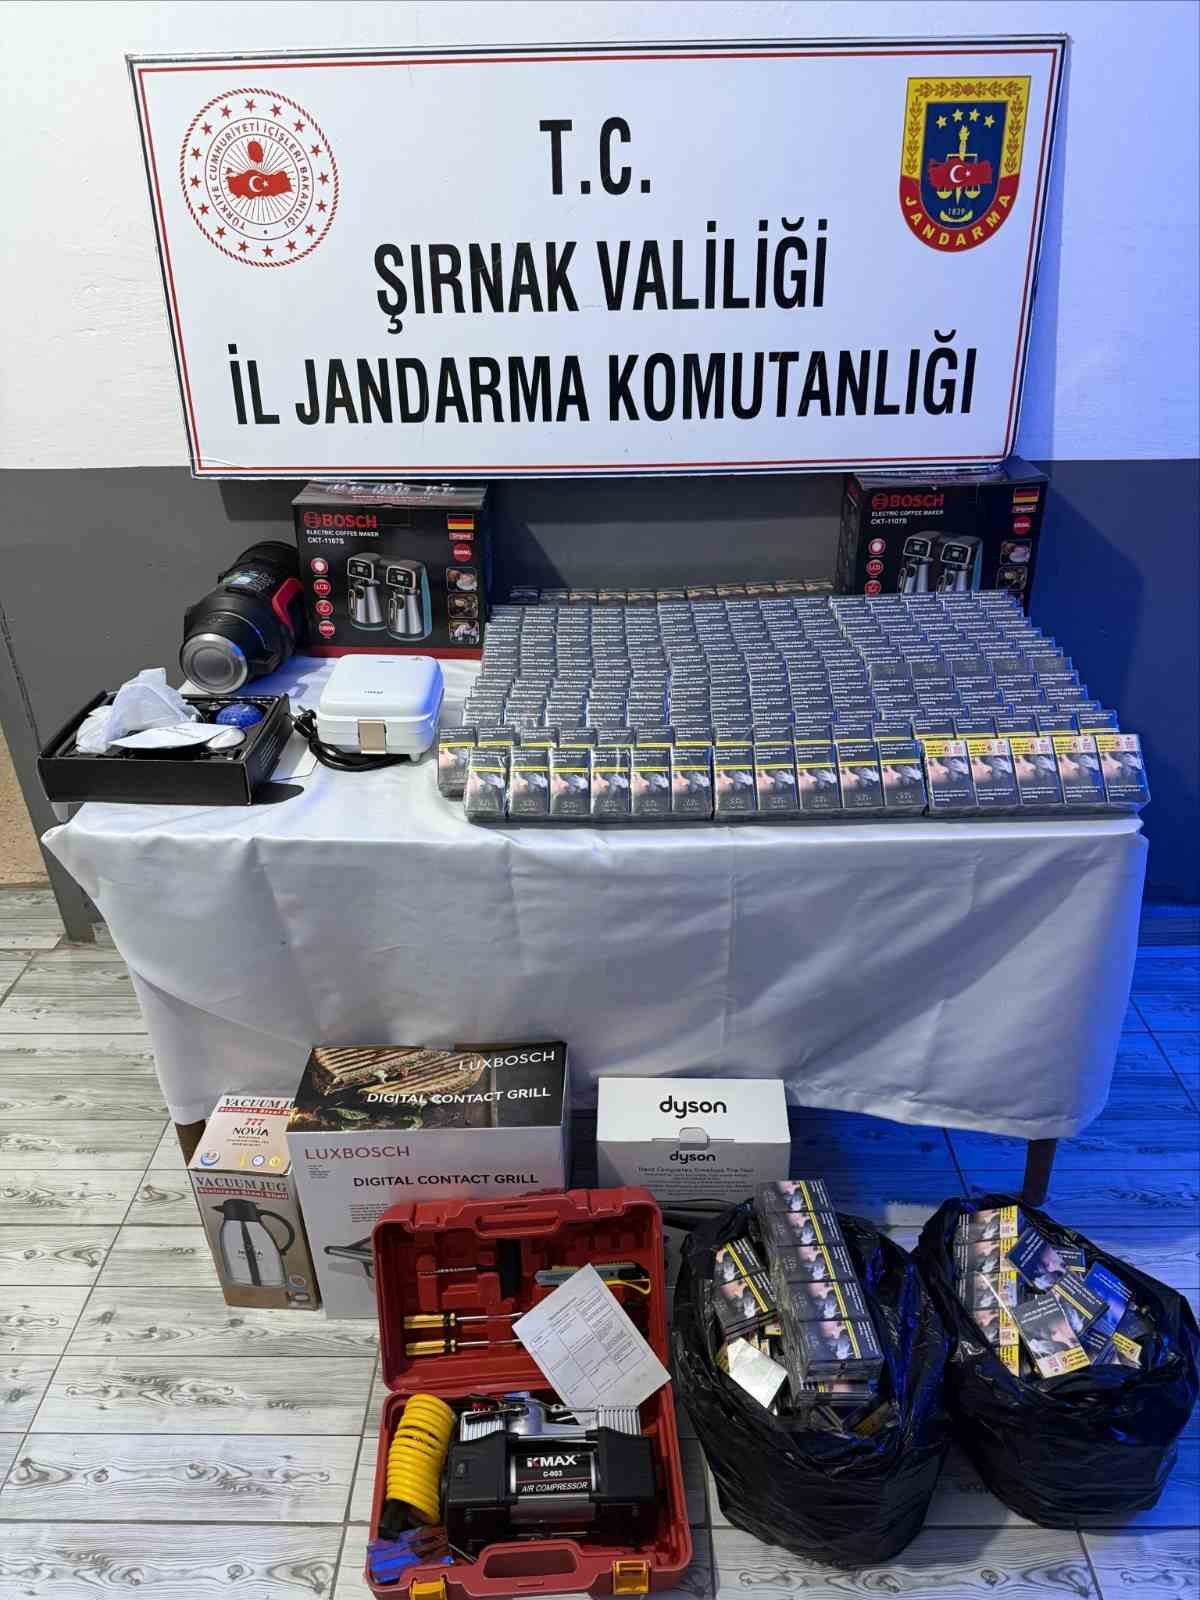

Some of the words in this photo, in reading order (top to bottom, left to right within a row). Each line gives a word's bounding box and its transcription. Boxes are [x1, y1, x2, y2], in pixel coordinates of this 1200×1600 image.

[209, 119, 260, 181] CUMHURİYETİ
[263, 121, 302, 163] İÇİŞLERİ
[539, 117, 651, 195] T.C.
[904, 194, 1011, 246] JANDARMA
[374, 241, 580, 335] ŞIRNAK
[597, 216, 829, 311] VALİLİĞİ
[227, 342, 281, 425] İL
[295, 354, 591, 425] JANDARMA
[608, 329, 978, 422] KOMUTANLIĞI
[890, 494, 945, 507] BOSCH
[322, 514, 377, 529] BOSCH
[459, 1050, 555, 1072] LUXBOSCH
[225, 1098, 280, 1108] VACUUM
[366, 1092, 428, 1105] DIGITAL
[431, 1091, 504, 1104] CONTACT
[507, 1087, 552, 1100] GRILL
[659, 1095, 728, 1119] dyson
[304, 1145, 411, 1160] LUXBOSCH
[669, 1150, 717, 1164] dyson
[194, 1176, 256, 1189] VACUUM
[260, 1181, 287, 1192] JUG
[353, 1175, 414, 1187] DIGITAL
[417, 1174, 490, 1186] CONTACT
[494, 1173, 539, 1184] GRILL
[526, 1455, 577, 1468] KMAX
[521, 1484, 534, 1493] AIR
[535, 1481, 588, 1493] COMPRESSOR
